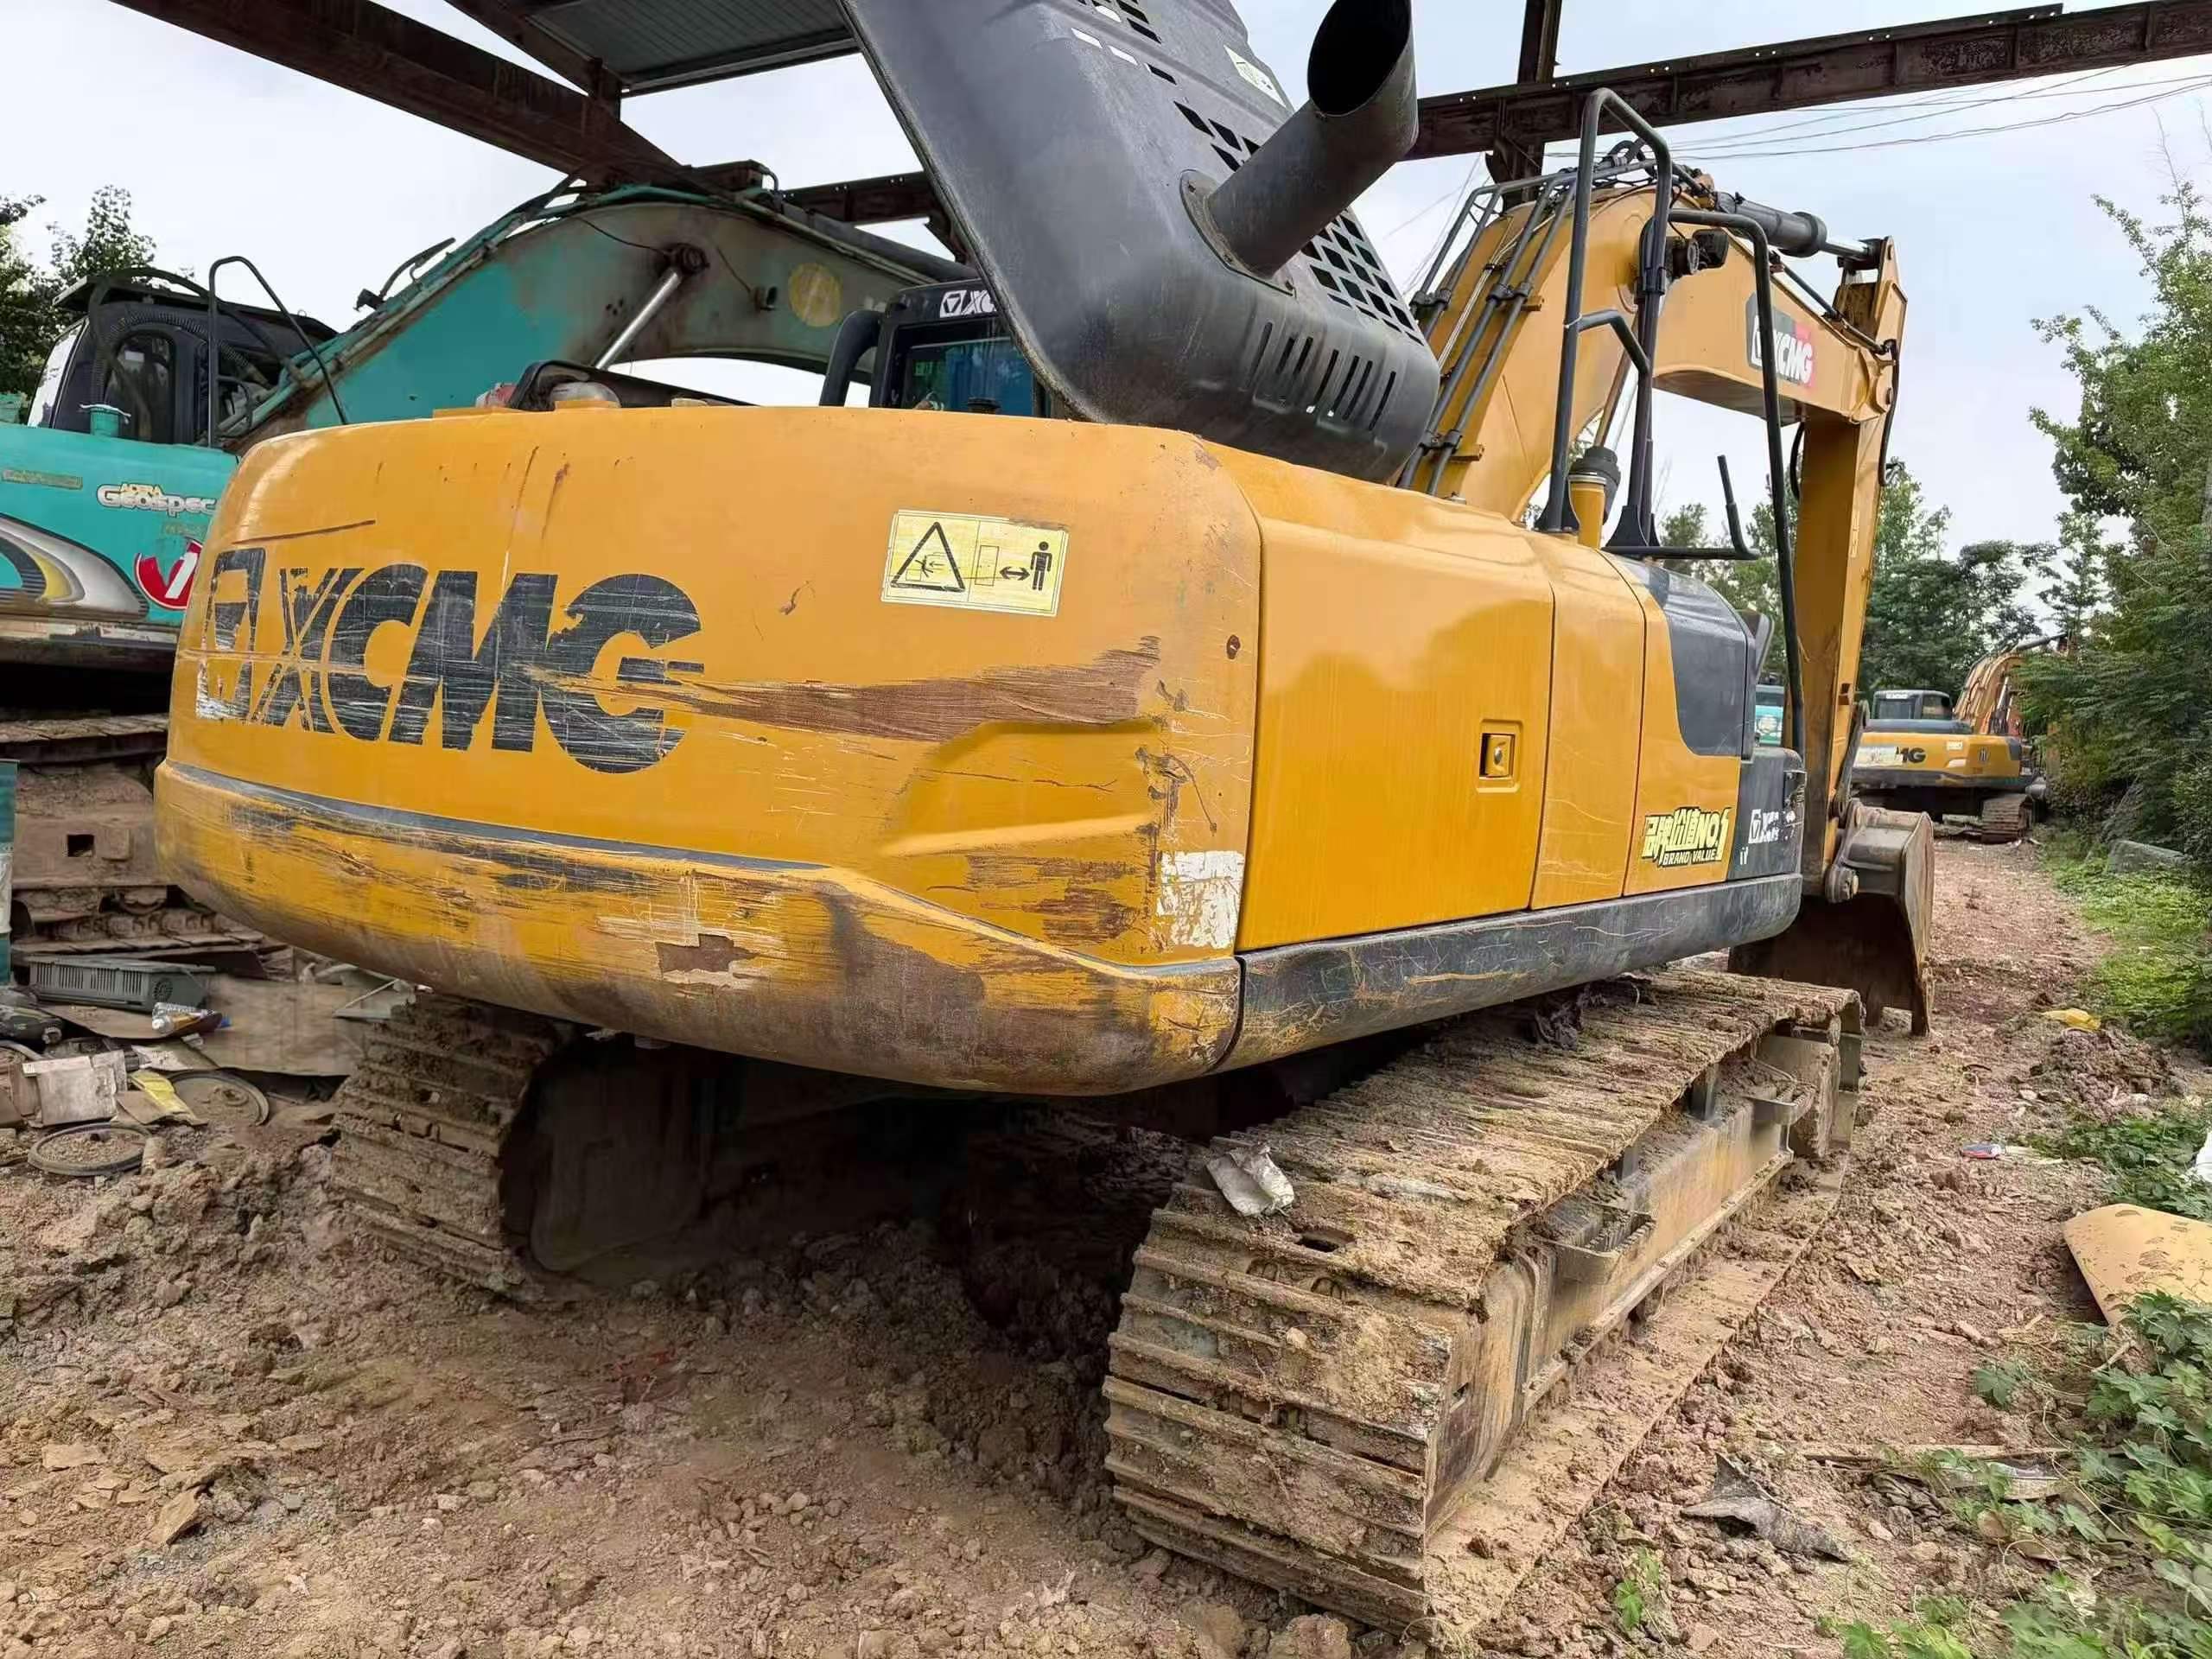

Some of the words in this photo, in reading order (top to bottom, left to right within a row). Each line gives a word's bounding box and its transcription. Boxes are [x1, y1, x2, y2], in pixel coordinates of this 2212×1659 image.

[962, 289, 997, 315] XC
[254, 563, 705, 774] XCMG
[1662, 850, 1690, 866] BRAND
[1692, 848, 1718, 863] VALUE
